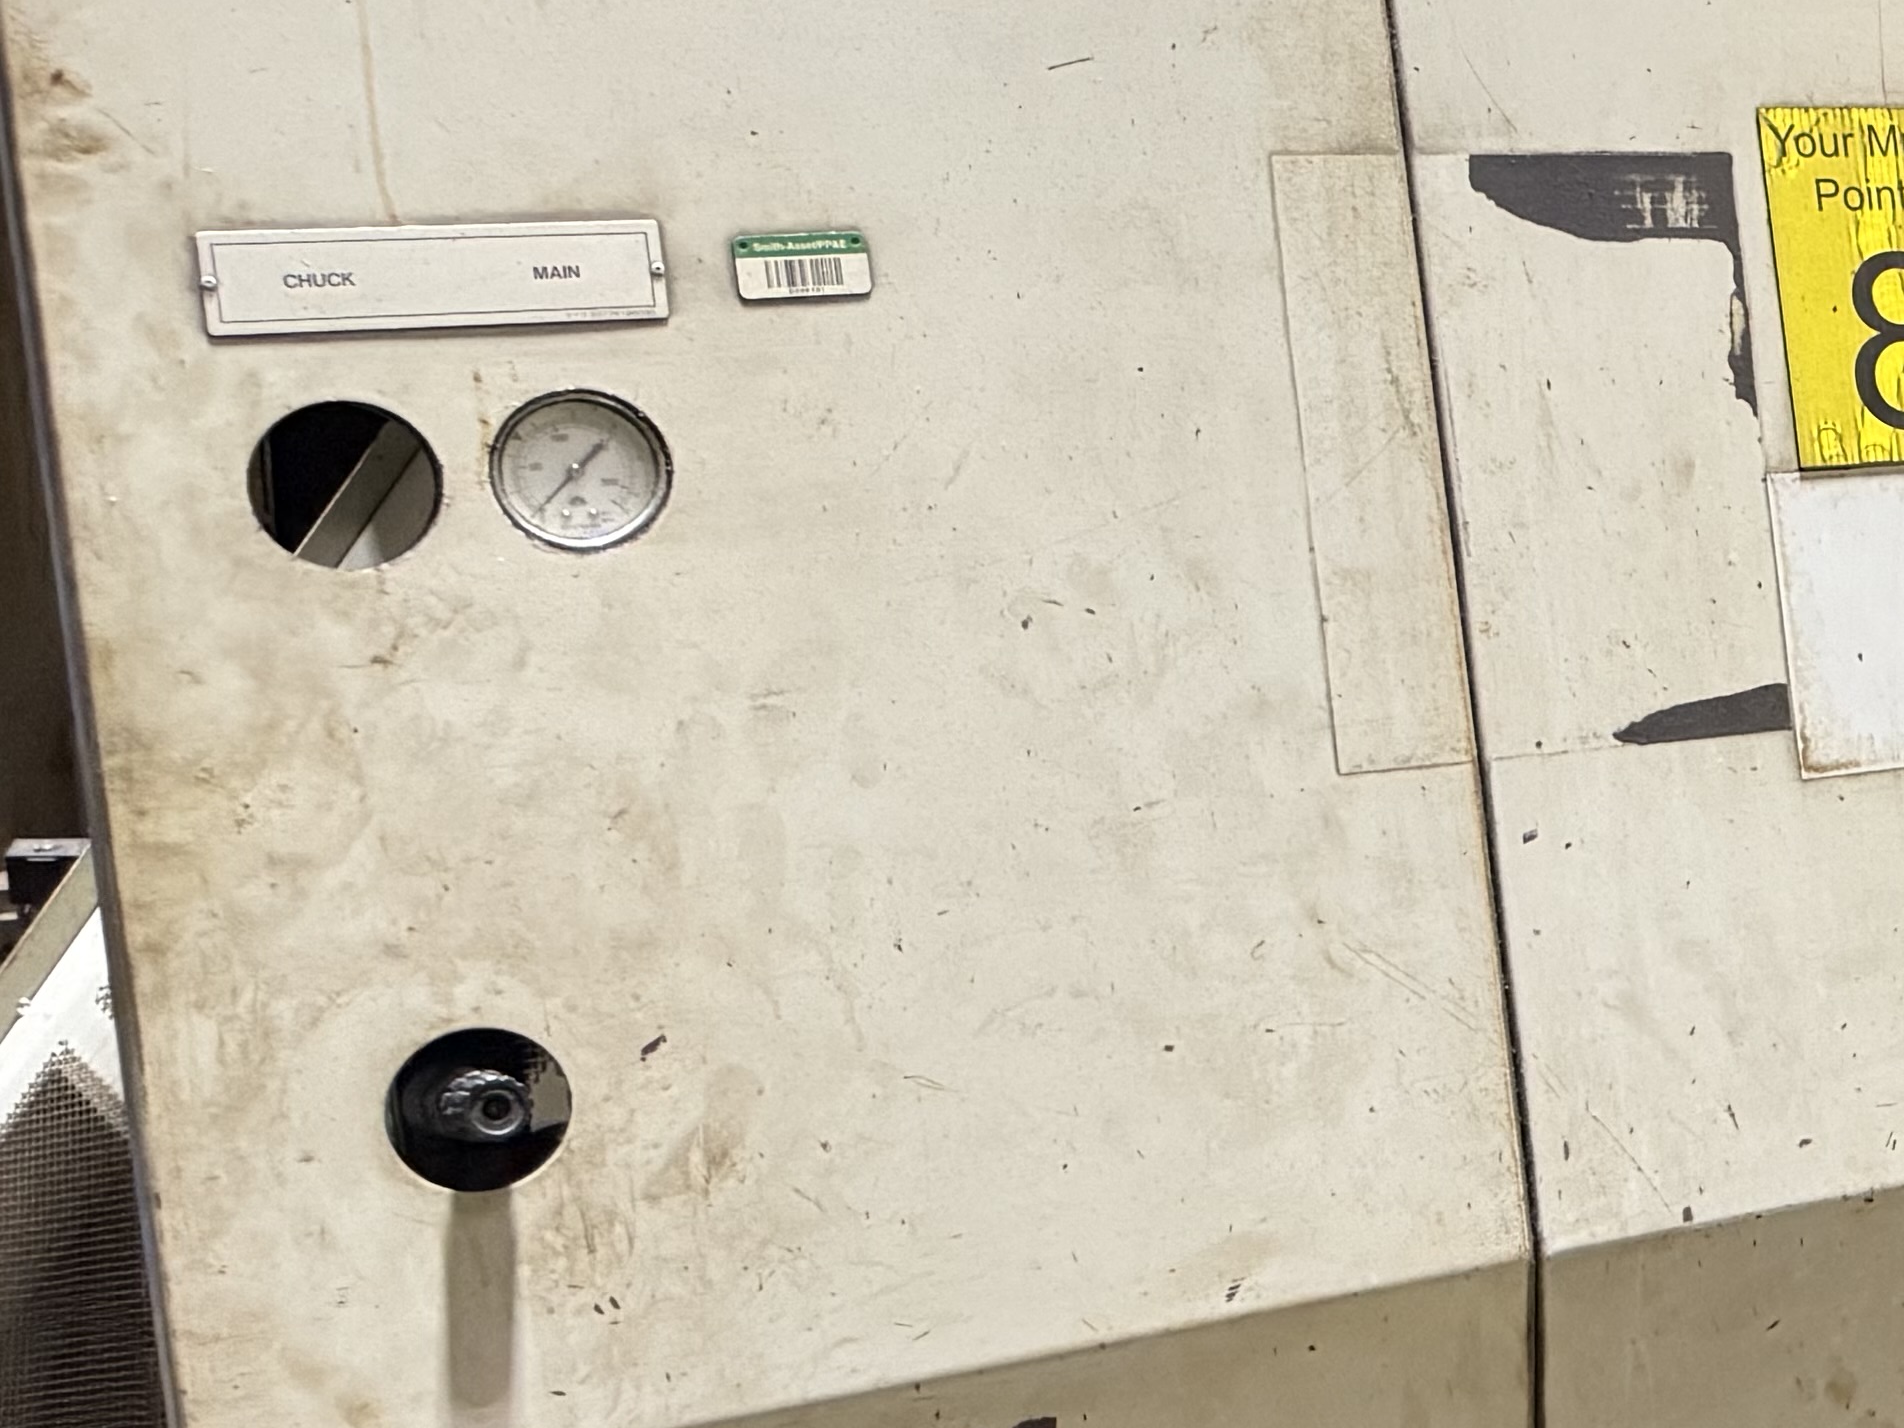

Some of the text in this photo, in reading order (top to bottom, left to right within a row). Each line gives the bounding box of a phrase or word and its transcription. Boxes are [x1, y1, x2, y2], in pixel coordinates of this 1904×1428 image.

[1775, 124, 1854, 158] Your
[283, 272, 355, 289] CHUCK
[532, 265, 580, 280] MAIN
